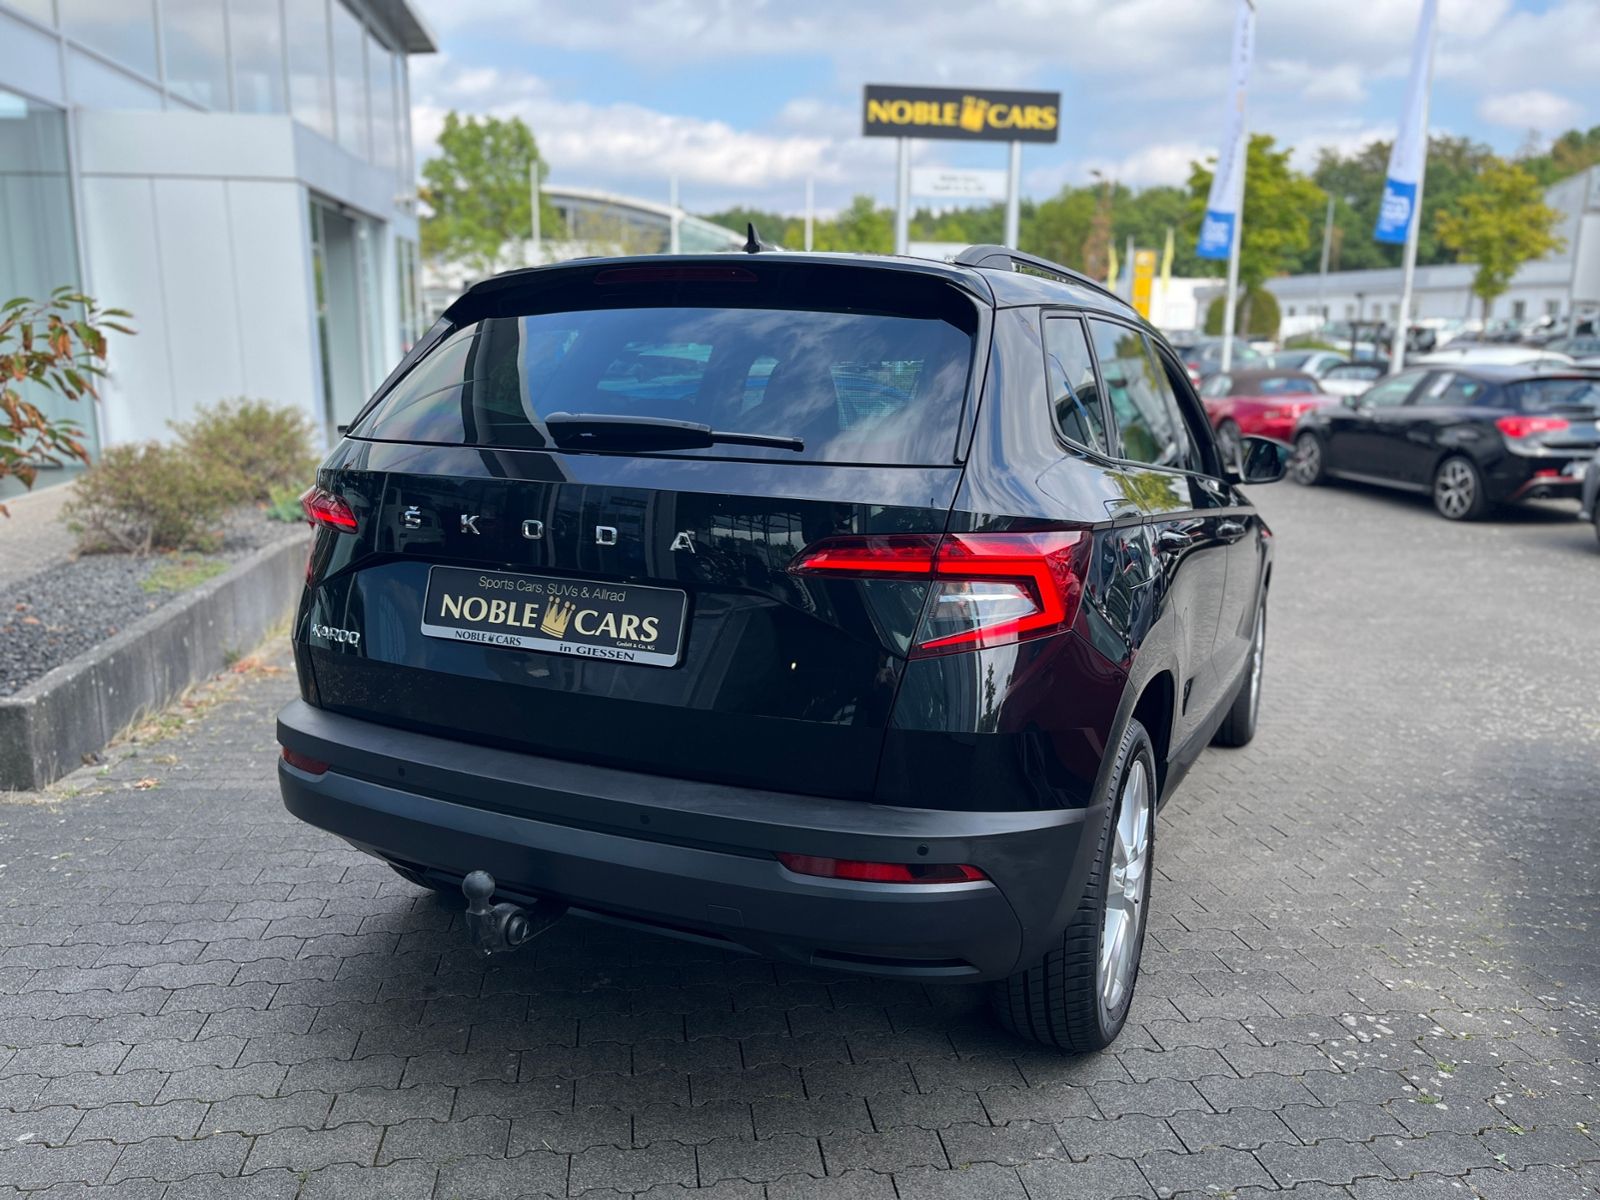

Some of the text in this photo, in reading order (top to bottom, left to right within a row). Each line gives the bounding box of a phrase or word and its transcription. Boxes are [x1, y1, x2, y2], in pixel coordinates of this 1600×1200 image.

[867, 99, 1057, 130] NOBLE CARS
[403, 505, 696, 554] ŠKODA
[479, 576, 626, 602] Sports Cars, SUVs & Allrad
[440, 593, 660, 642] NOBLE CARS
[455, 630, 521, 646] NOBLE CARS
[560, 643, 635, 661] in GIESSEN
